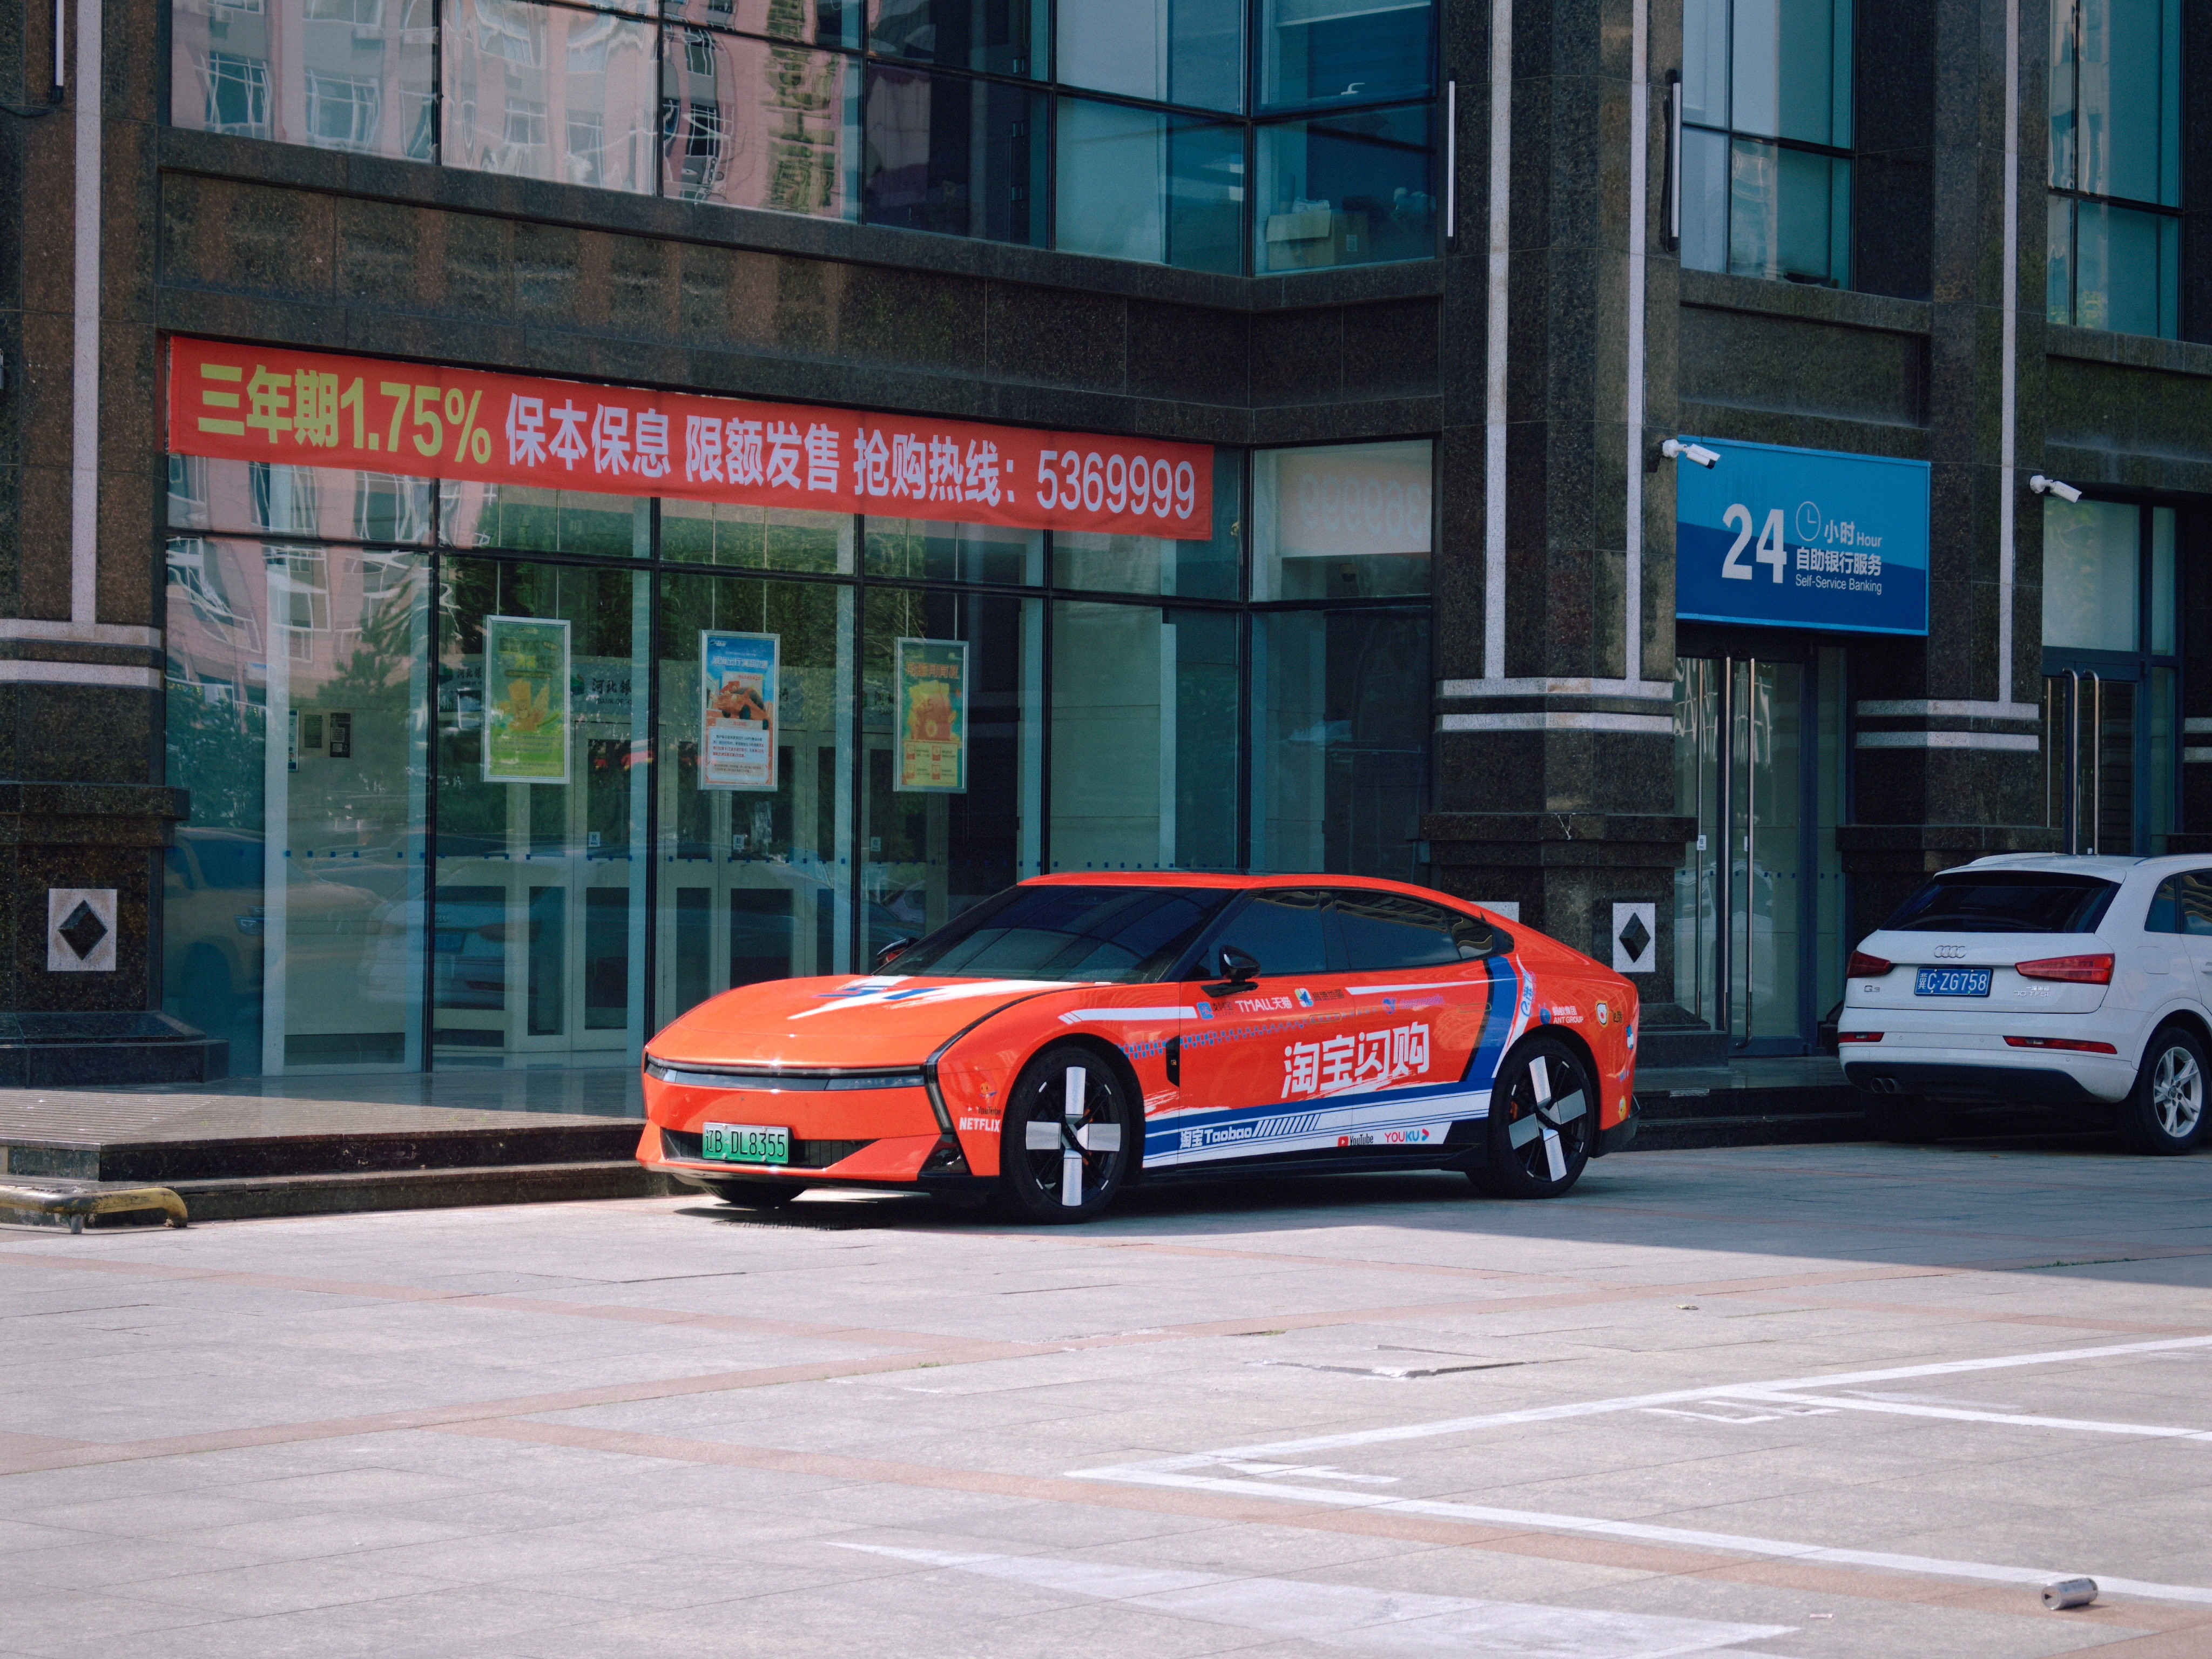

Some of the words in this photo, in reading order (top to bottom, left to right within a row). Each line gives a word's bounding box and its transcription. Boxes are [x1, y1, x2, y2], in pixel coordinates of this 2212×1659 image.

[196, 363, 491, 464] 三年期1.75%
[505, 393, 671, 478] 保本保息
[685, 415, 840, 493] 限额发售
[1036, 450, 1195, 520] 5369999
[1722, 503, 1787, 583] 24
[1824, 520, 1855, 545] 小时
[1857, 532, 1882, 548] Hour
[1796, 547, 1882, 576] 自助银行服务
[1796, 574, 1846, 590] Self-Service
[1849, 577, 1882, 595] Banking
[1553, 1016, 1566, 1024] ANT
[1281, 1022, 1429, 1098] 淘宝闪购
[959, 1117, 1001, 1132] NETFLIX
[1385, 1130, 1419, 1142] YOUKU
[1350, 1134, 1373, 1145] YouTube
